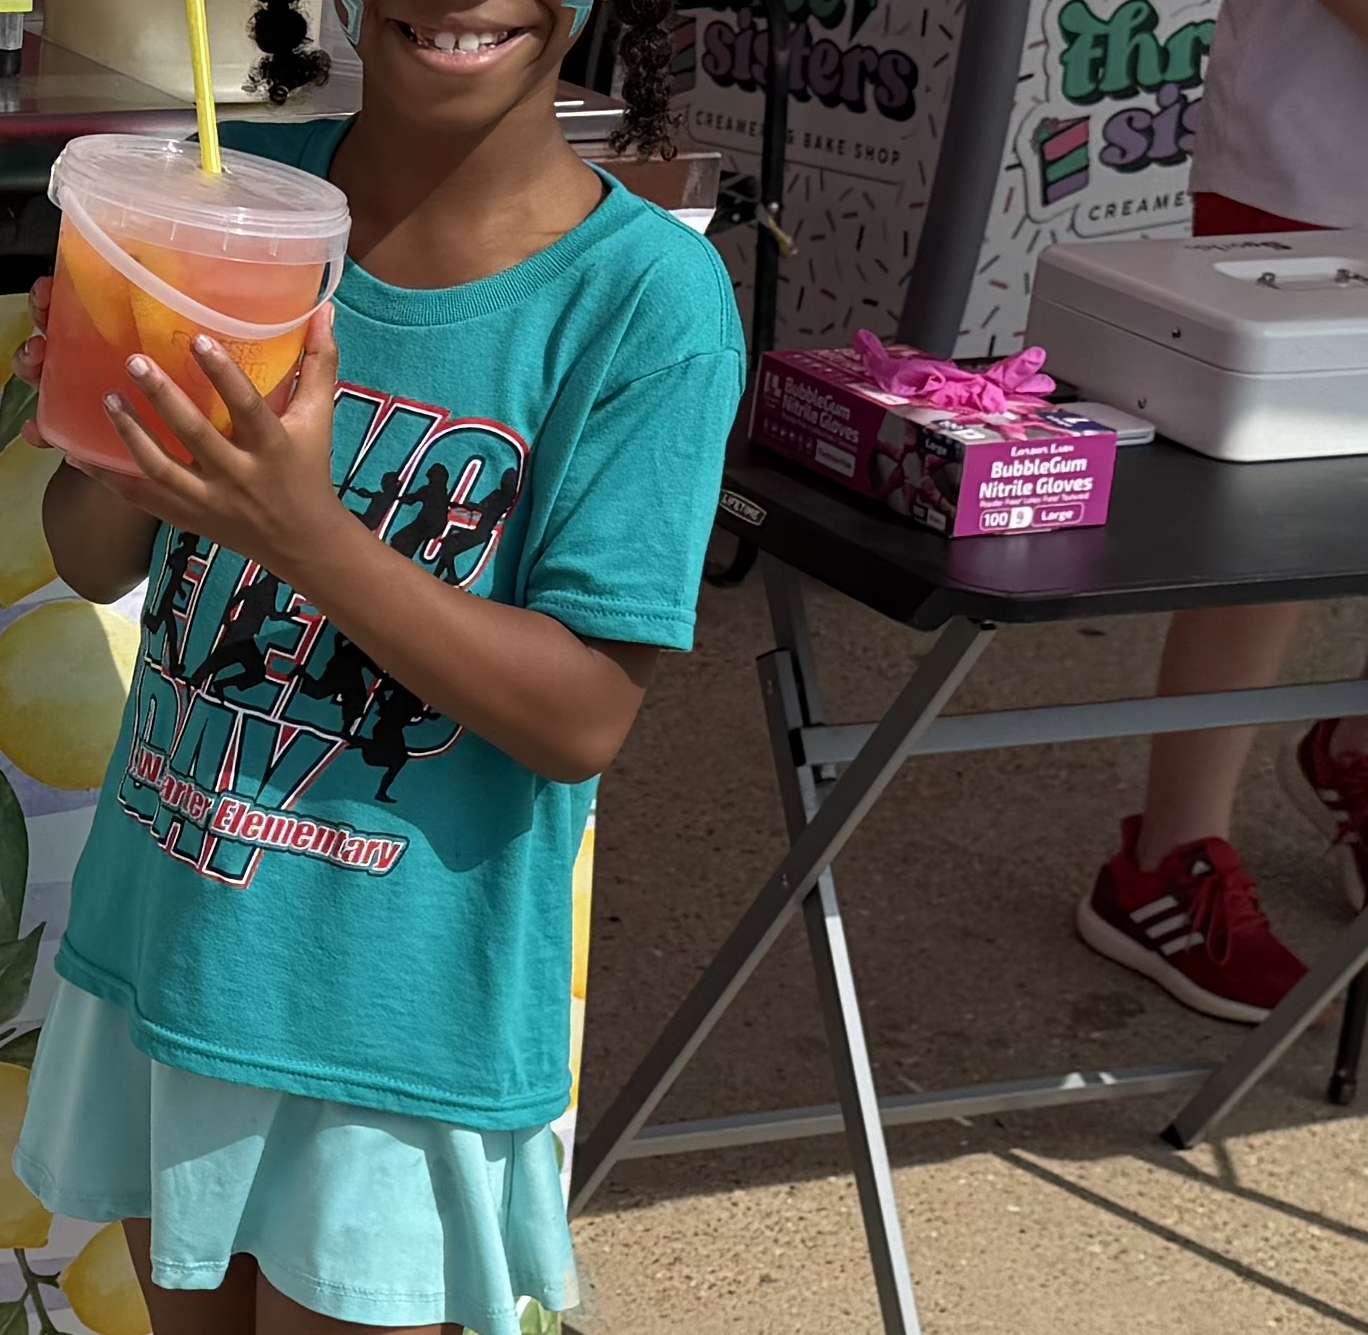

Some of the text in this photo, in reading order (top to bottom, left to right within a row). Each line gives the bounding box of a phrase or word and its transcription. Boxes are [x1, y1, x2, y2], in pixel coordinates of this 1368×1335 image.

[695, 110, 763, 137] CREAME
[803, 132, 845, 155] BAKE
[854, 143, 901, 165] SHOP
[1088, 190, 1186, 221] CREAME
[990, 456, 1088, 479] BubbleGum
[979, 476, 1094, 499] Nitrile Gloves
[984, 509, 1074, 527] 100 Large
[214, 796, 406, 873] Elementary
